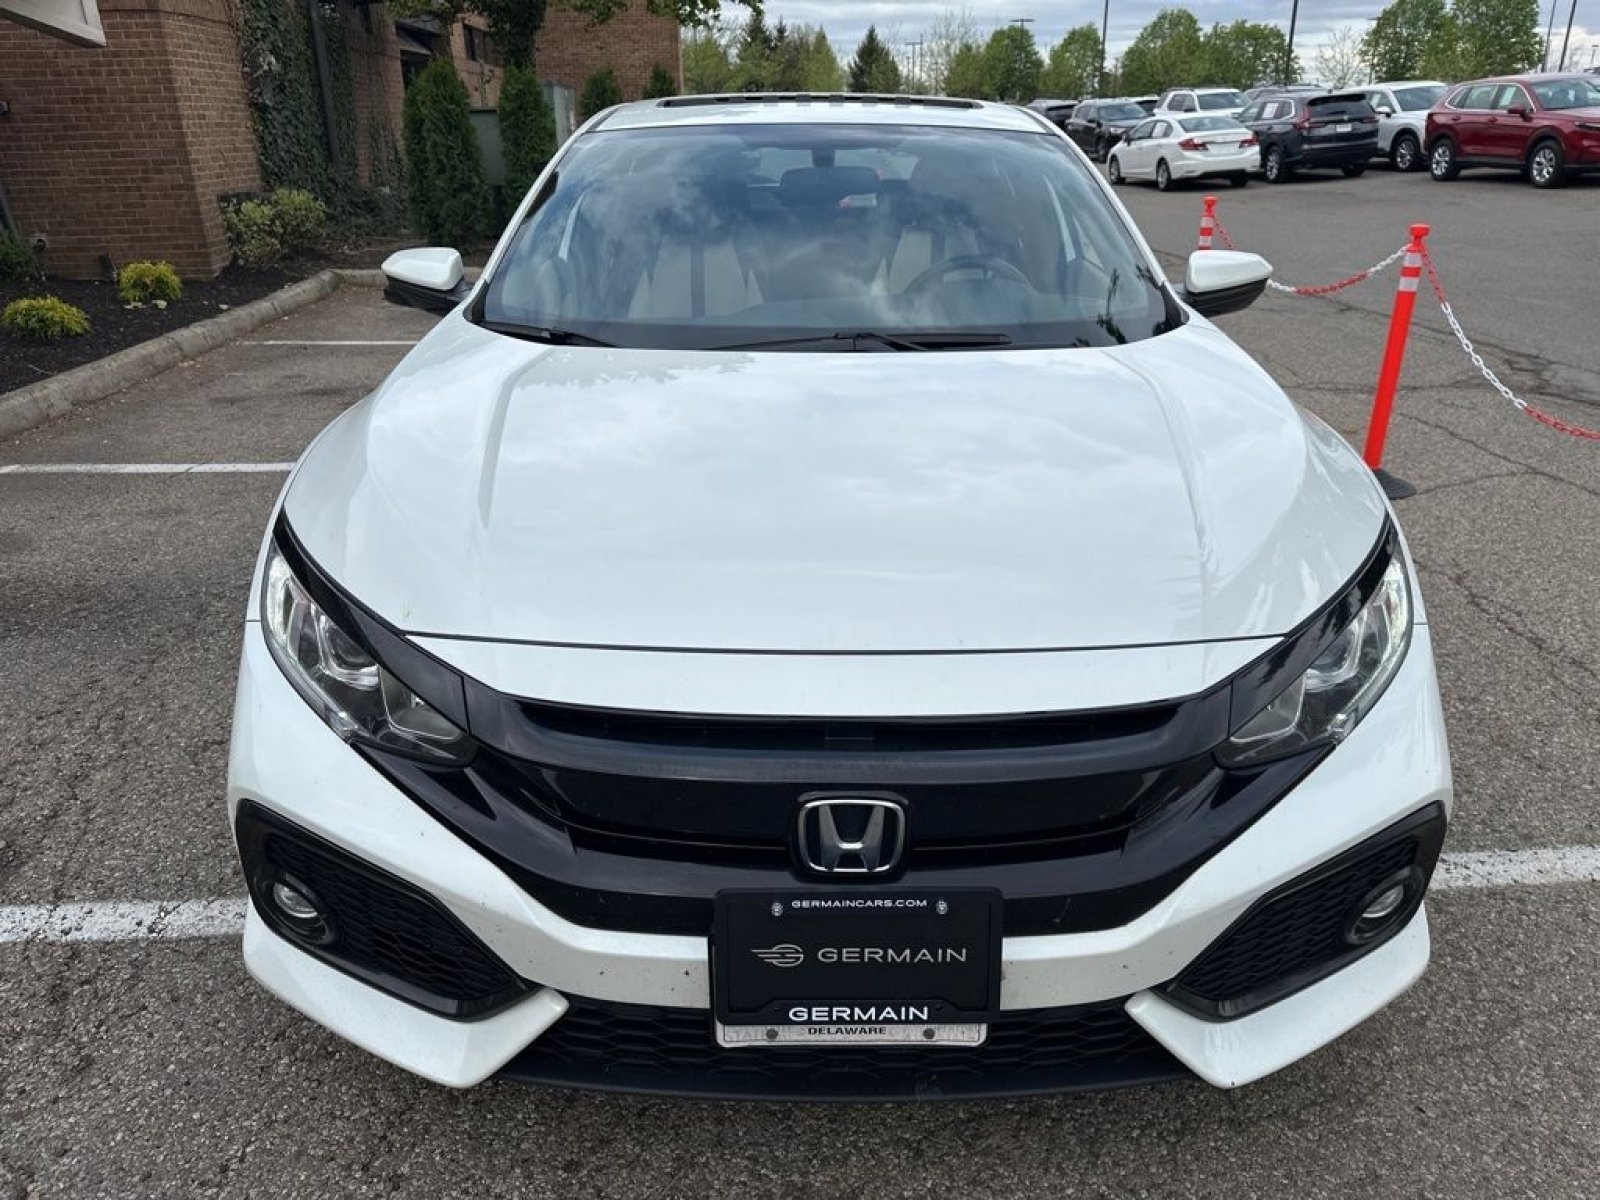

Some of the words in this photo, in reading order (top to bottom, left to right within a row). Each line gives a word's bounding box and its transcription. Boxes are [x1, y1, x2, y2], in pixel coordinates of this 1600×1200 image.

[791, 899, 928, 908] GERMAINCARS.COM
[818, 947, 967, 963] GERMAIN
[788, 1006, 929, 1021] GERMAIN
[807, 1026, 886, 1035] DELAWARE
